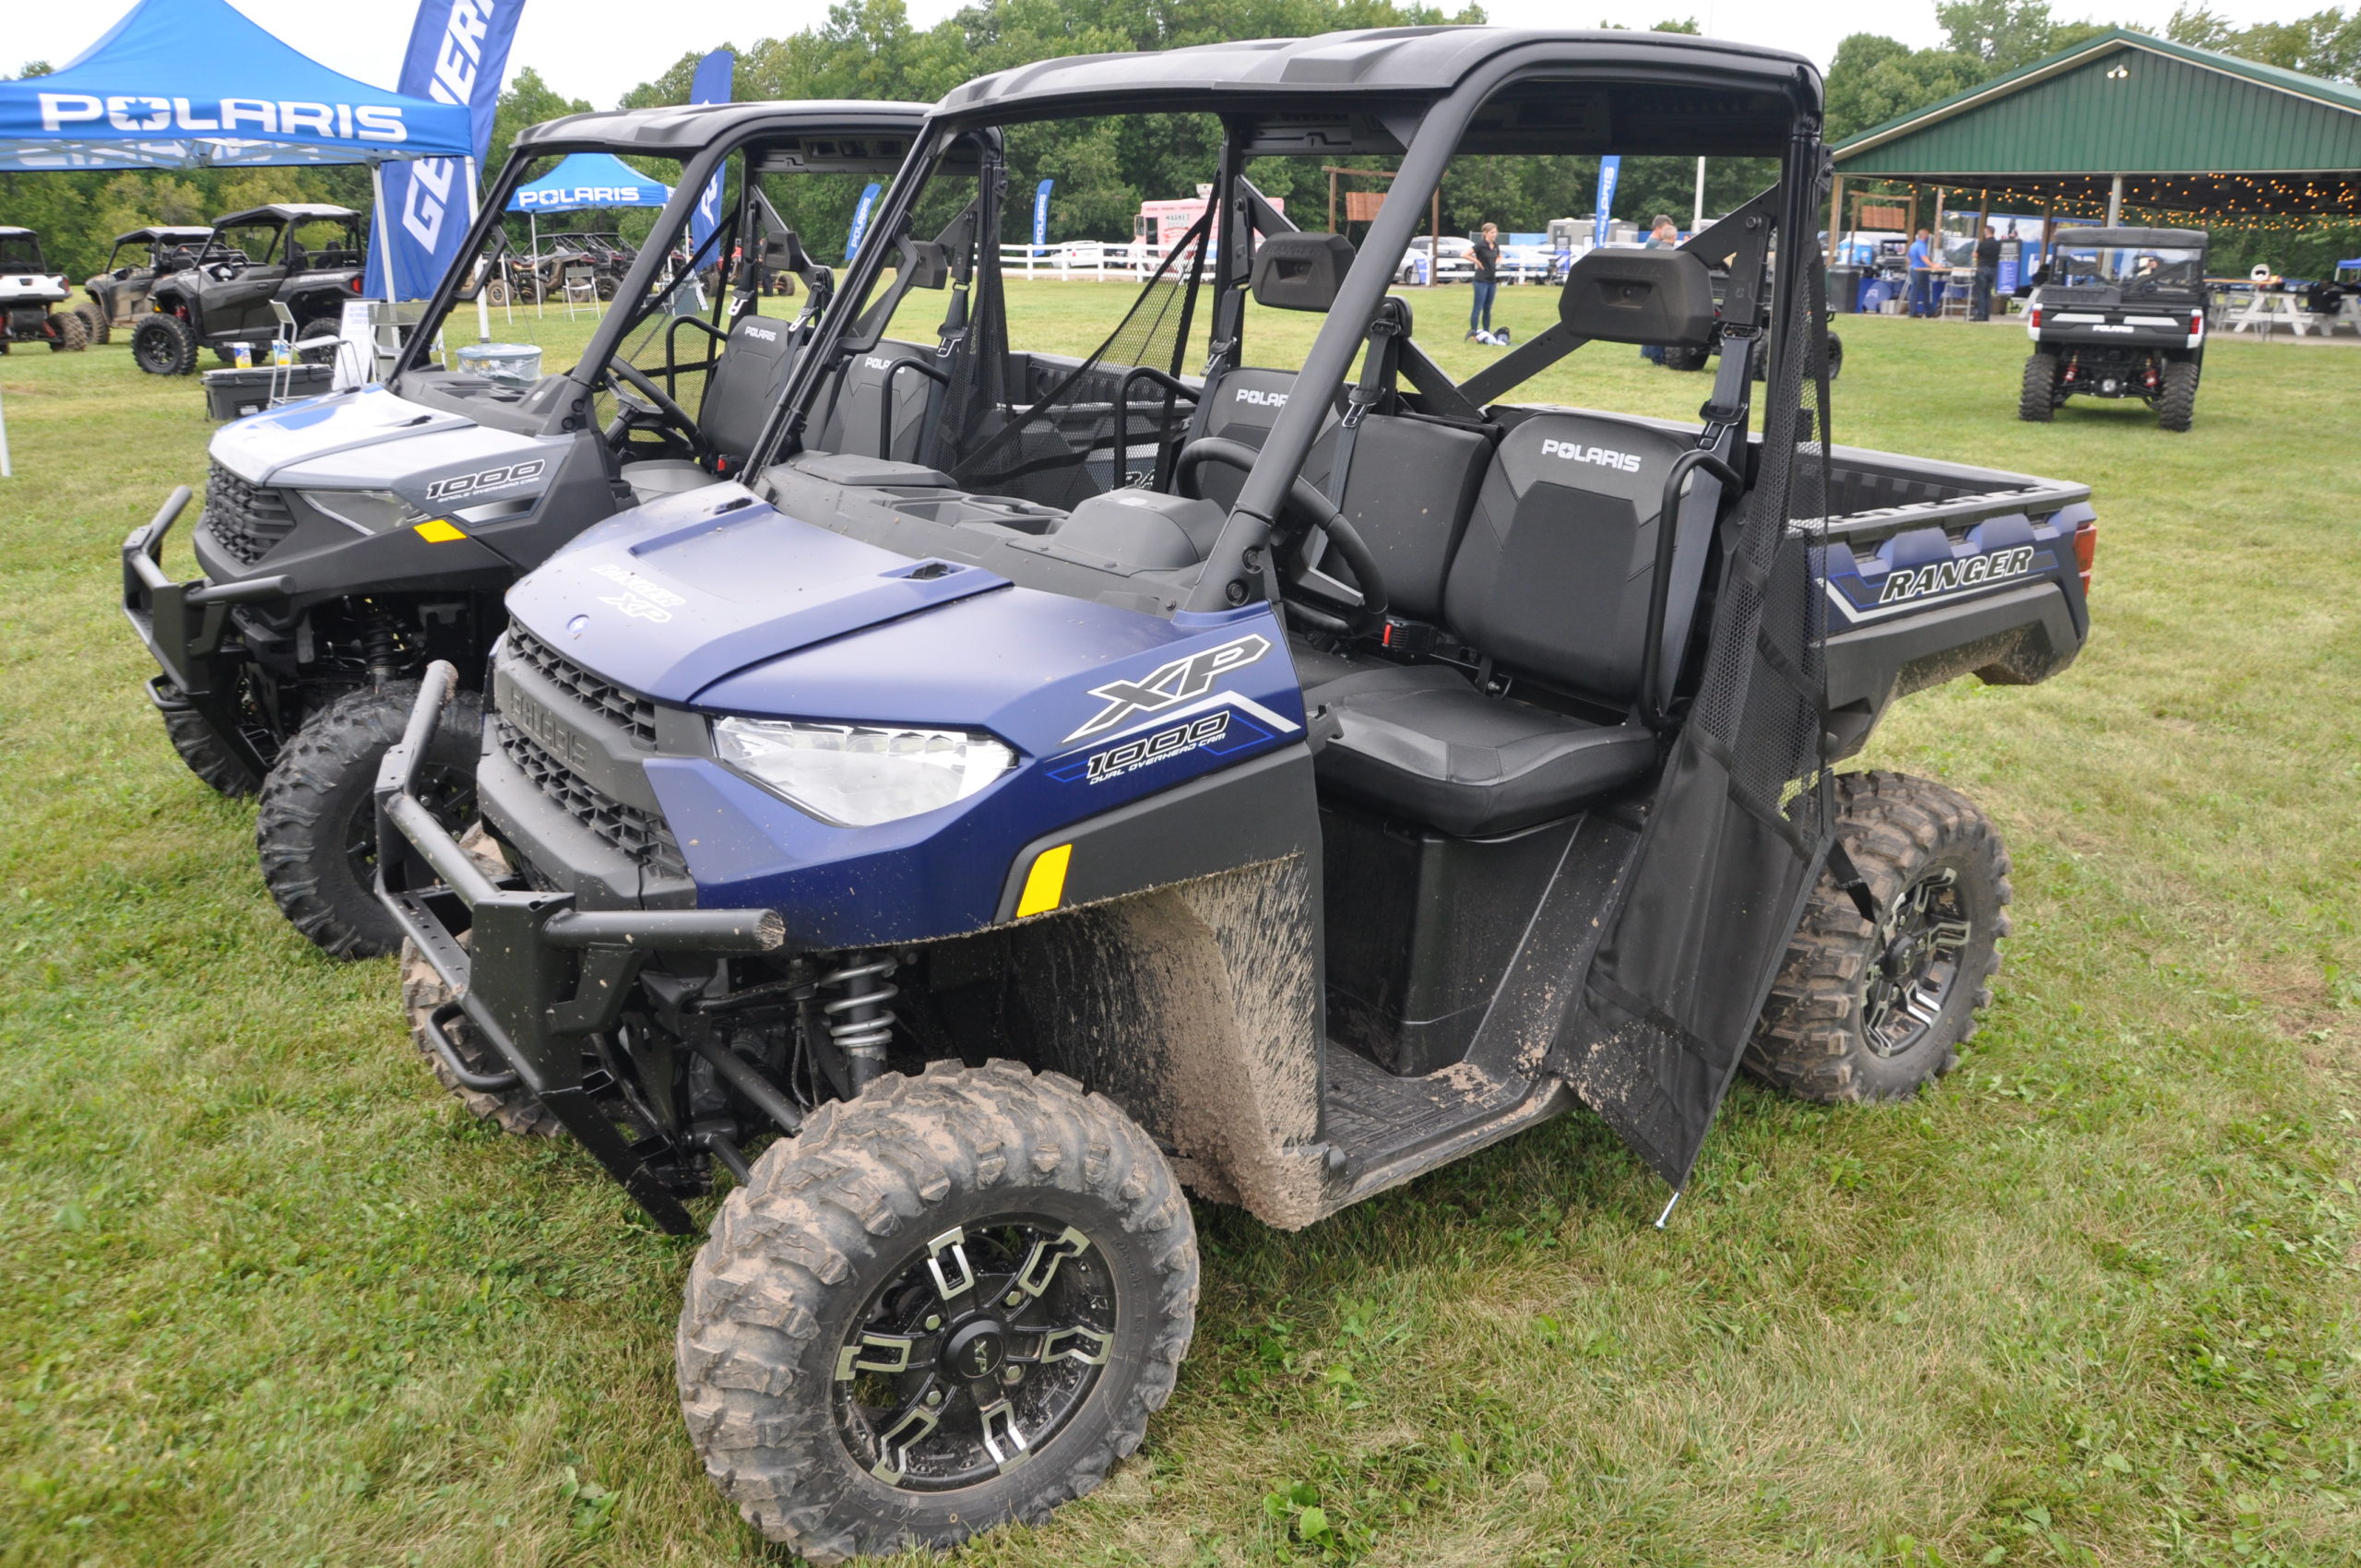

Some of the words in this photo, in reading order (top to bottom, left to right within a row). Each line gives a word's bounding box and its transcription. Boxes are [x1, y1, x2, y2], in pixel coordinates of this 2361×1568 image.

[39, 93, 409, 143] POLARIS
[518, 187, 640, 208] POLARIS
[1037, 194, 1047, 244] POLARIS
[851, 197, 872, 248] POLARIS
[744, 326, 777, 342] POLARIS
[1541, 439, 1642, 473] POLARIS
[426, 459, 546, 500] 1000
[437, 491, 471, 503] SINGLE
[520, 476, 540, 485] CAM
[590, 564, 687, 608] RANGER
[1879, 546, 2034, 604] RANGER
[596, 591, 672, 624] XP
[1062, 634, 1271, 743] XP
[1086, 710, 1229, 779] 1000
[1089, 768, 1125, 785] DUAL
[1128, 742, 1197, 771] OVERHEAD
[1198, 732, 1227, 747] CAM
[974, 1338, 988, 1374] XP
